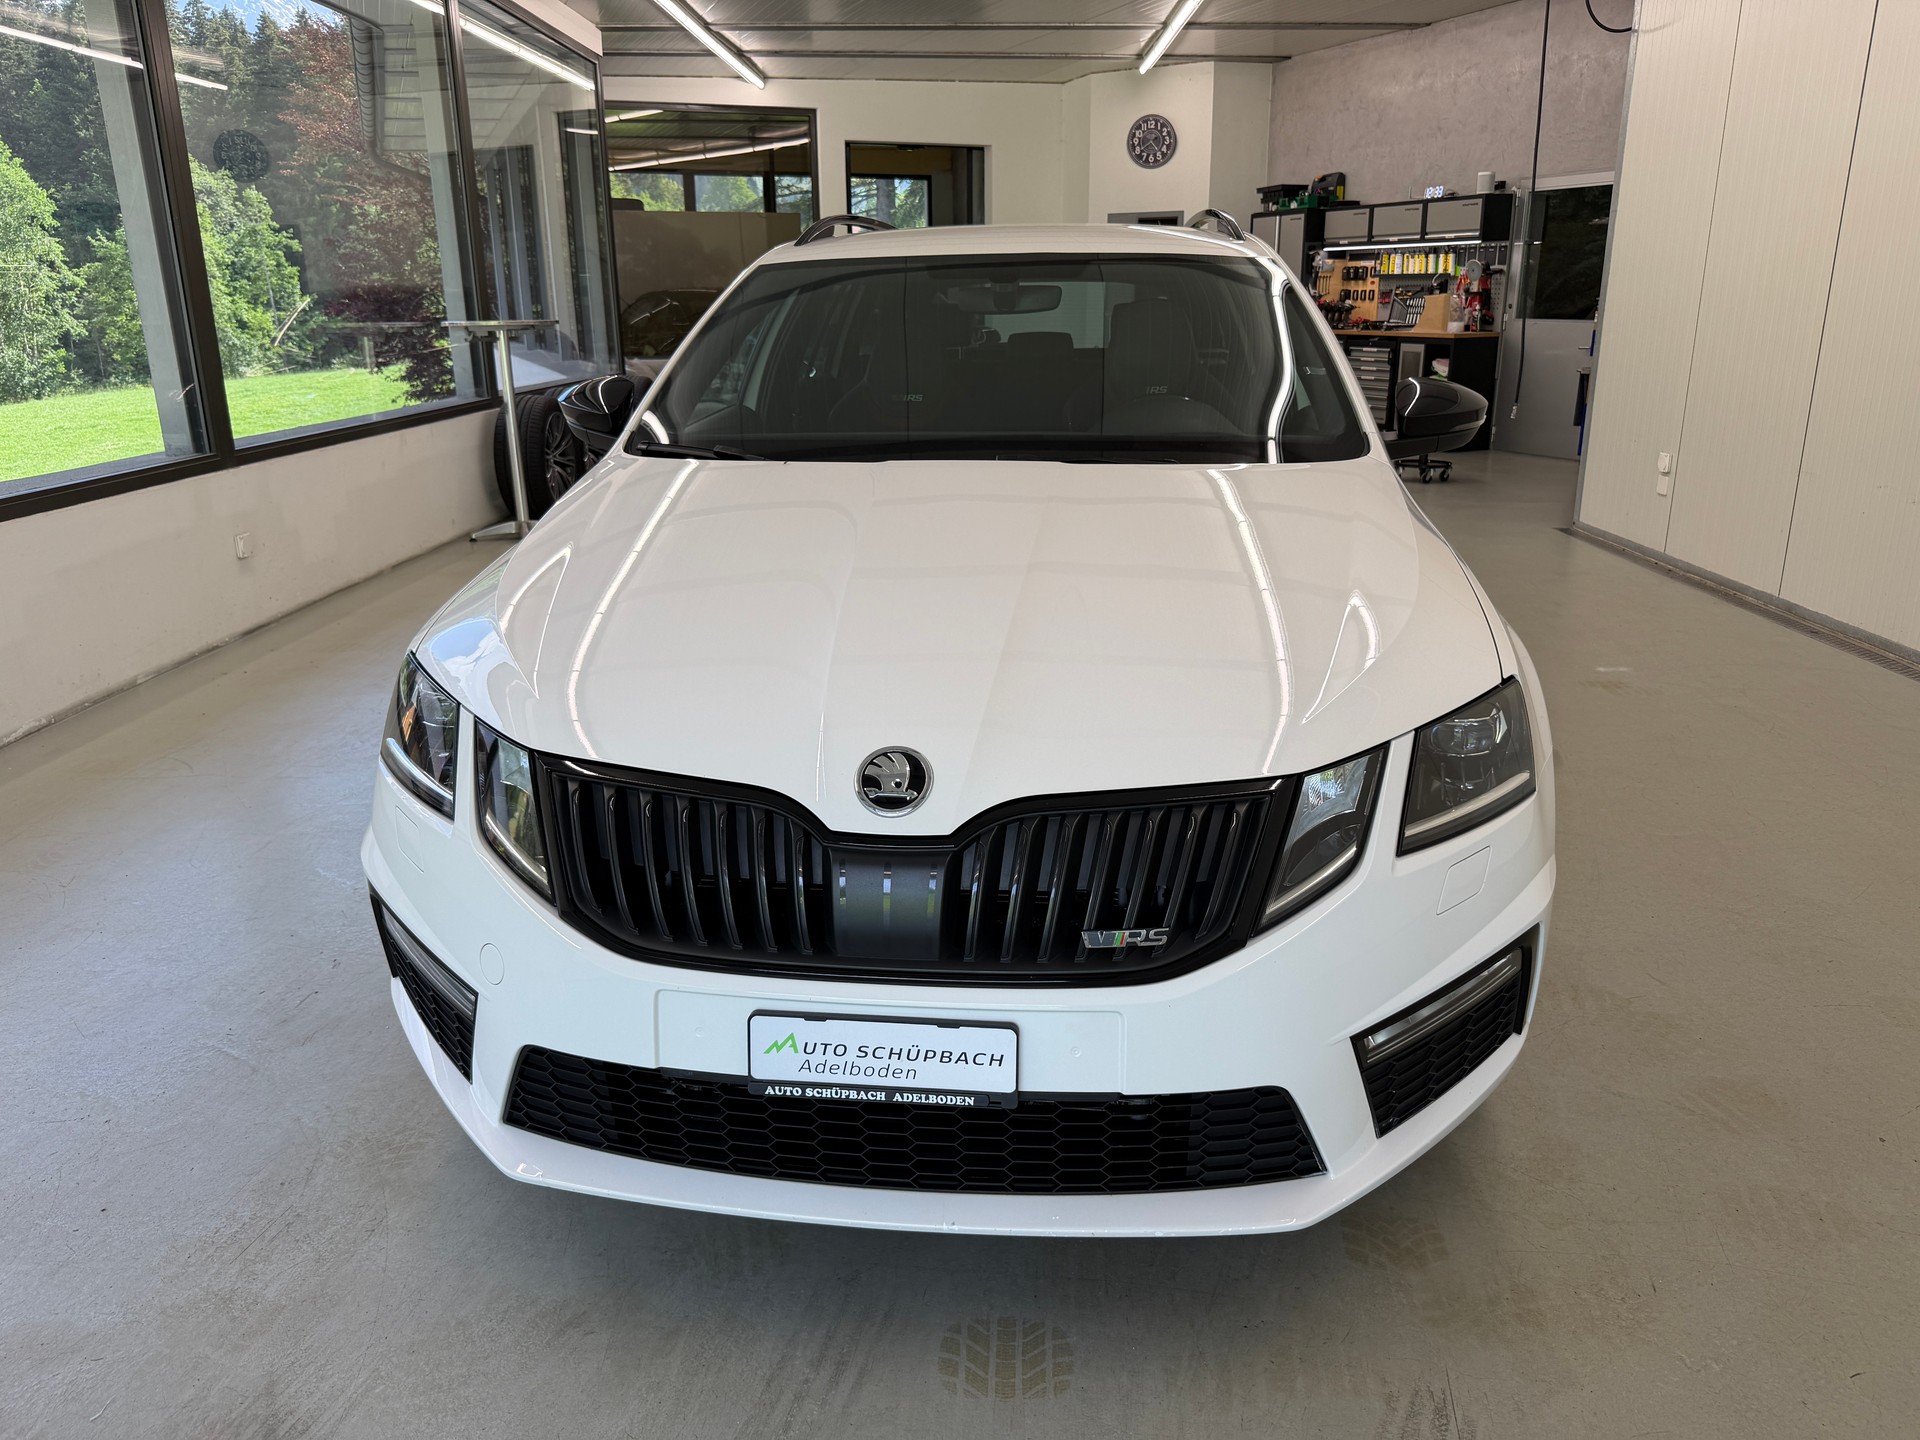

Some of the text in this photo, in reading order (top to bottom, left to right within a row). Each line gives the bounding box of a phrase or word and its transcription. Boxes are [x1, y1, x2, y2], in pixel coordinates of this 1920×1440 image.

[1133, 138, 1139, 146] 9
[1164, 136, 1169, 144] 3
[1135, 146, 1140, 154] 8
[1162, 145, 1167, 153] 4
[1142, 153, 1147, 161] 7
[1156, 152, 1162, 160] 5
[856, 1044, 1005, 1067] SCHÜPBACH
[798, 1059, 918, 1080] Adelboden
[764, 1085, 975, 1106] AUTO SCHÜPBACH ADELBODEN
